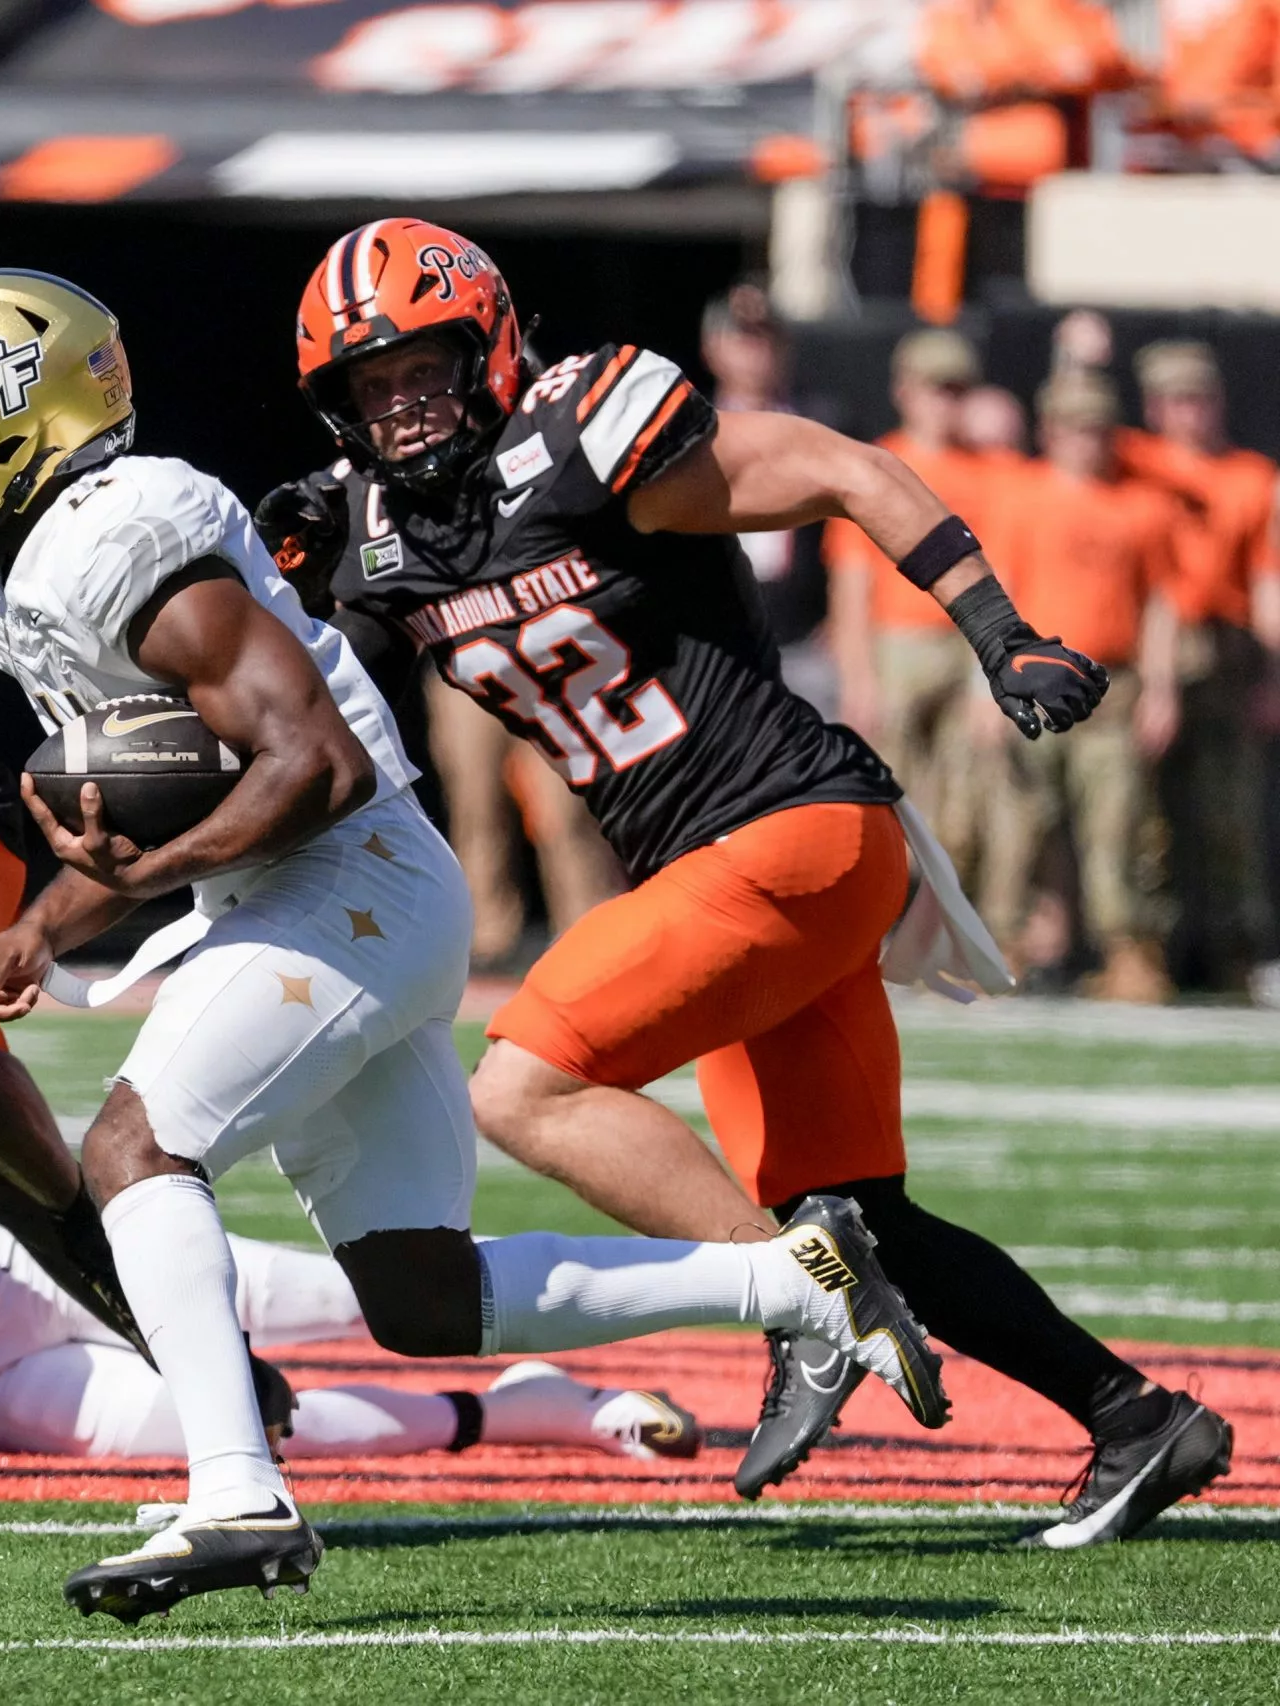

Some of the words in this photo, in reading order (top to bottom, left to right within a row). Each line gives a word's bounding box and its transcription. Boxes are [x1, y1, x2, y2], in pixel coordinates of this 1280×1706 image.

[511, 548, 601, 615] STATE
[446, 602, 689, 787] 32
[788, 1236, 857, 1293] NIKE
